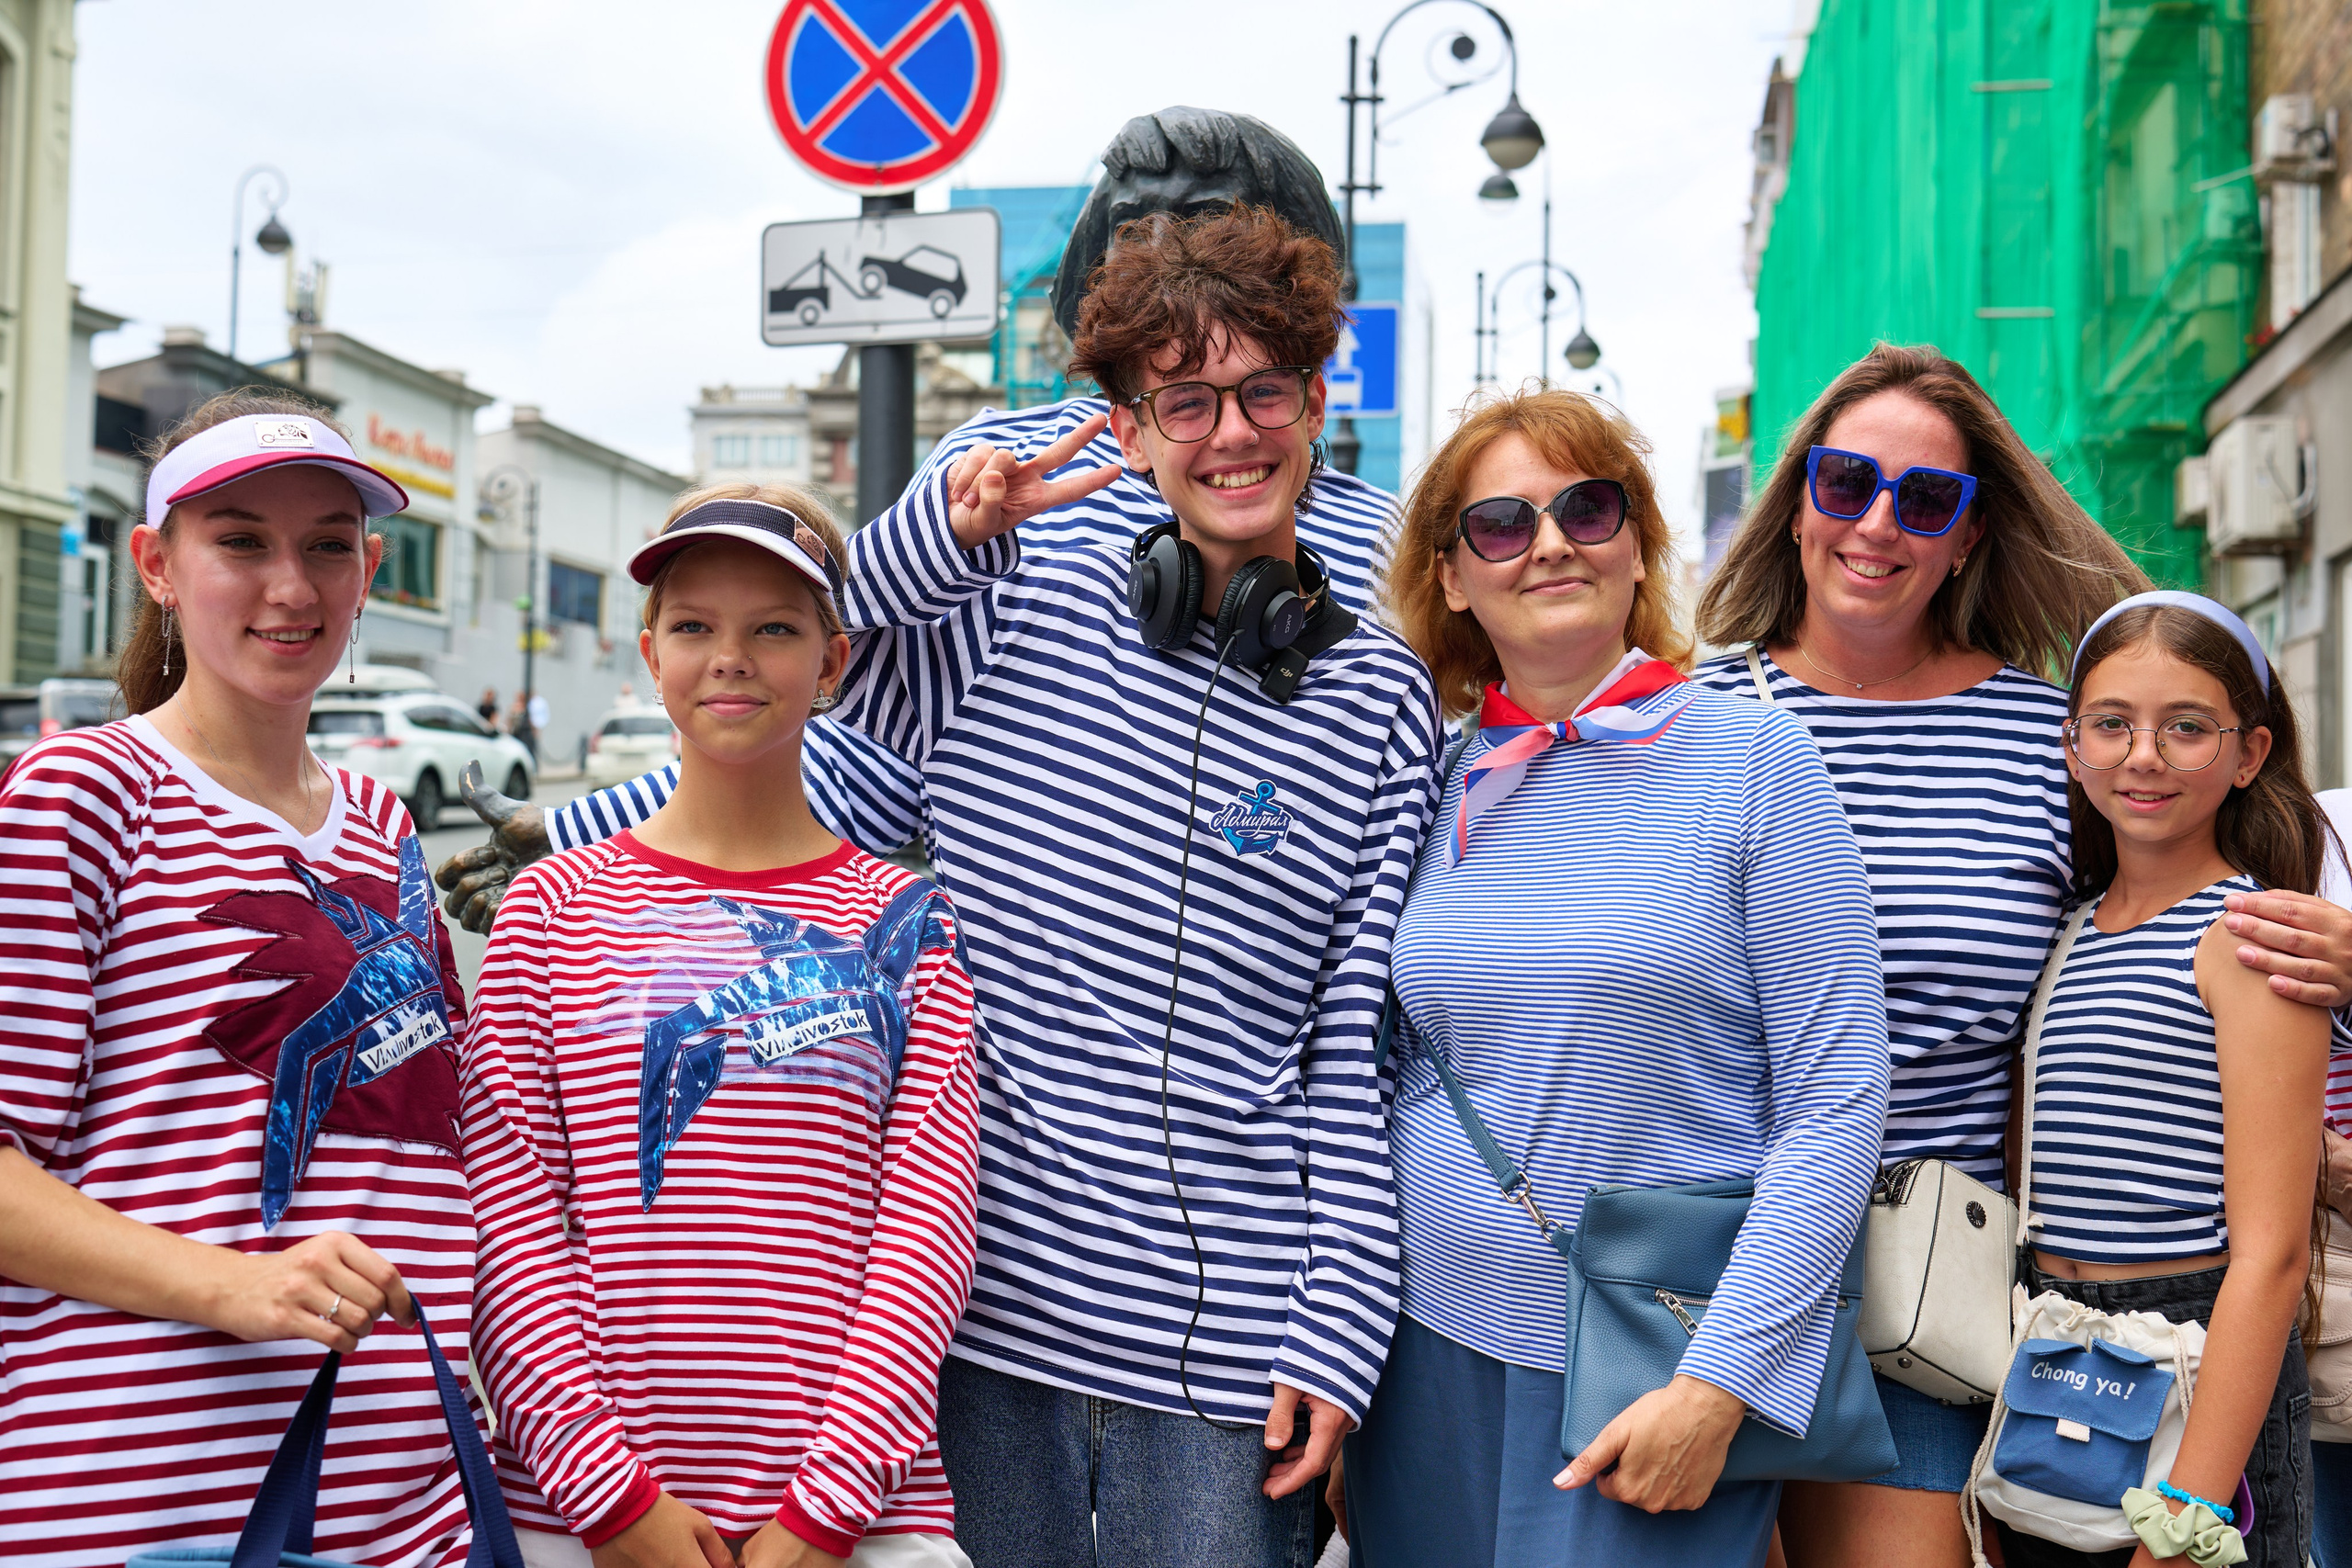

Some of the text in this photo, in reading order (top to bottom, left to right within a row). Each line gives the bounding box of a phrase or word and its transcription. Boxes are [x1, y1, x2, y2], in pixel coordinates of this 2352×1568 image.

[1213, 805, 1288, 838] Адмирал
[2031, 1361, 2136, 1400] Chong ya!
